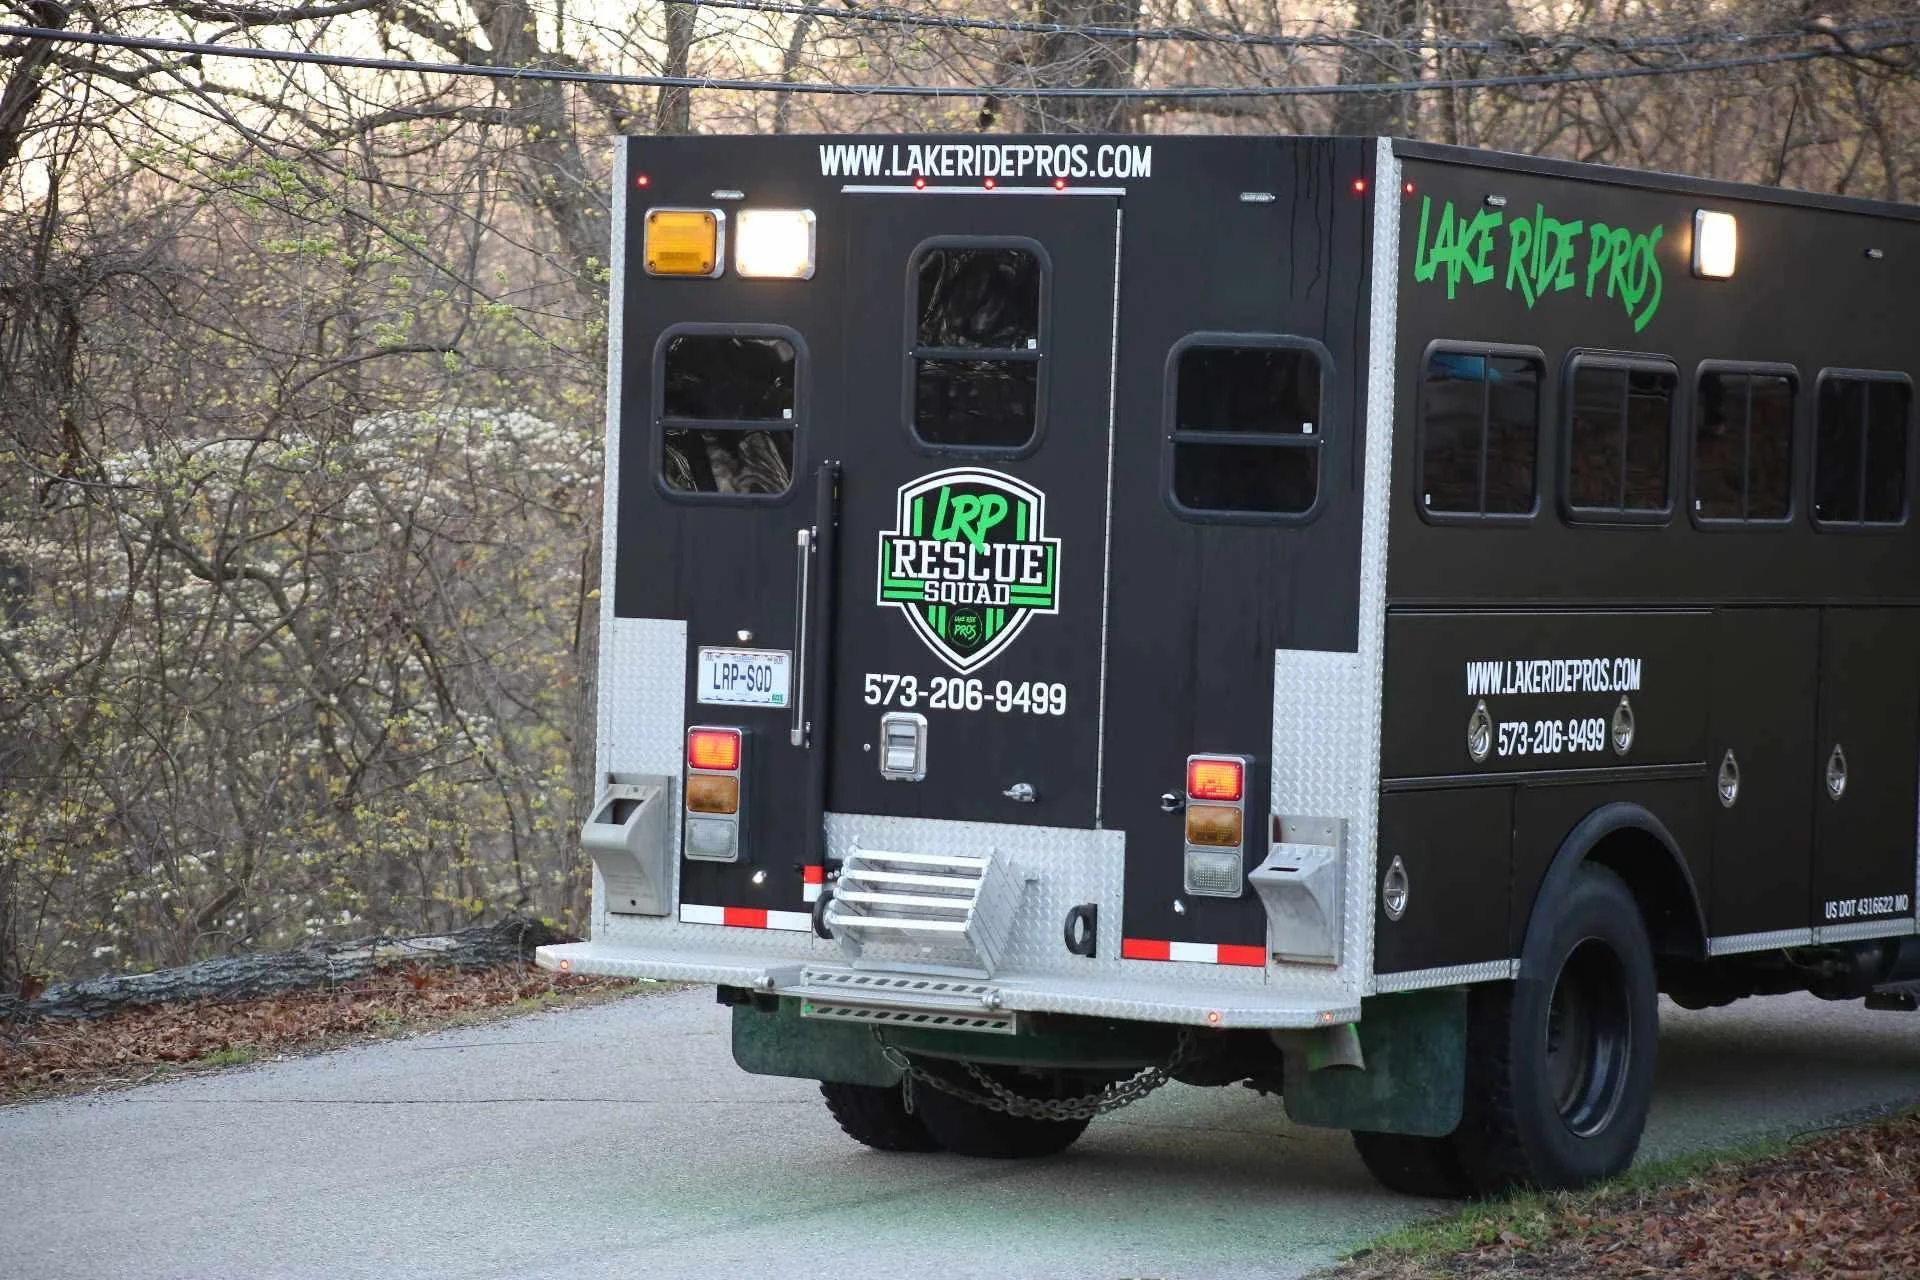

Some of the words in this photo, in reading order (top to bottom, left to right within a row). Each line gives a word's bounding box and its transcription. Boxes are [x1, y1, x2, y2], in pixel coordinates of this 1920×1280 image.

[819, 144, 1152, 178] WWW.LAKERIDEPROS.COM
[1414, 195, 1503, 300] LAKE
[1505, 203, 1583, 310] RIDE
[1586, 223, 1664, 333] PROS
[931, 485, 1009, 554] LRP
[891, 539, 1043, 584] RESCUE
[924, 580, 1011, 606] SQUAD
[713, 662, 773, 693] LRP-SQD
[864, 673, 1067, 716] 573-206-9499
[1466, 657, 1642, 696] WWW.LAKERIDEPROS.COM
[1498, 718, 1606, 756] 573-206-9499
[1825, 901, 1838, 919] US
[1838, 899, 1857, 918] DOT
[1895, 894, 1909, 912] MO
